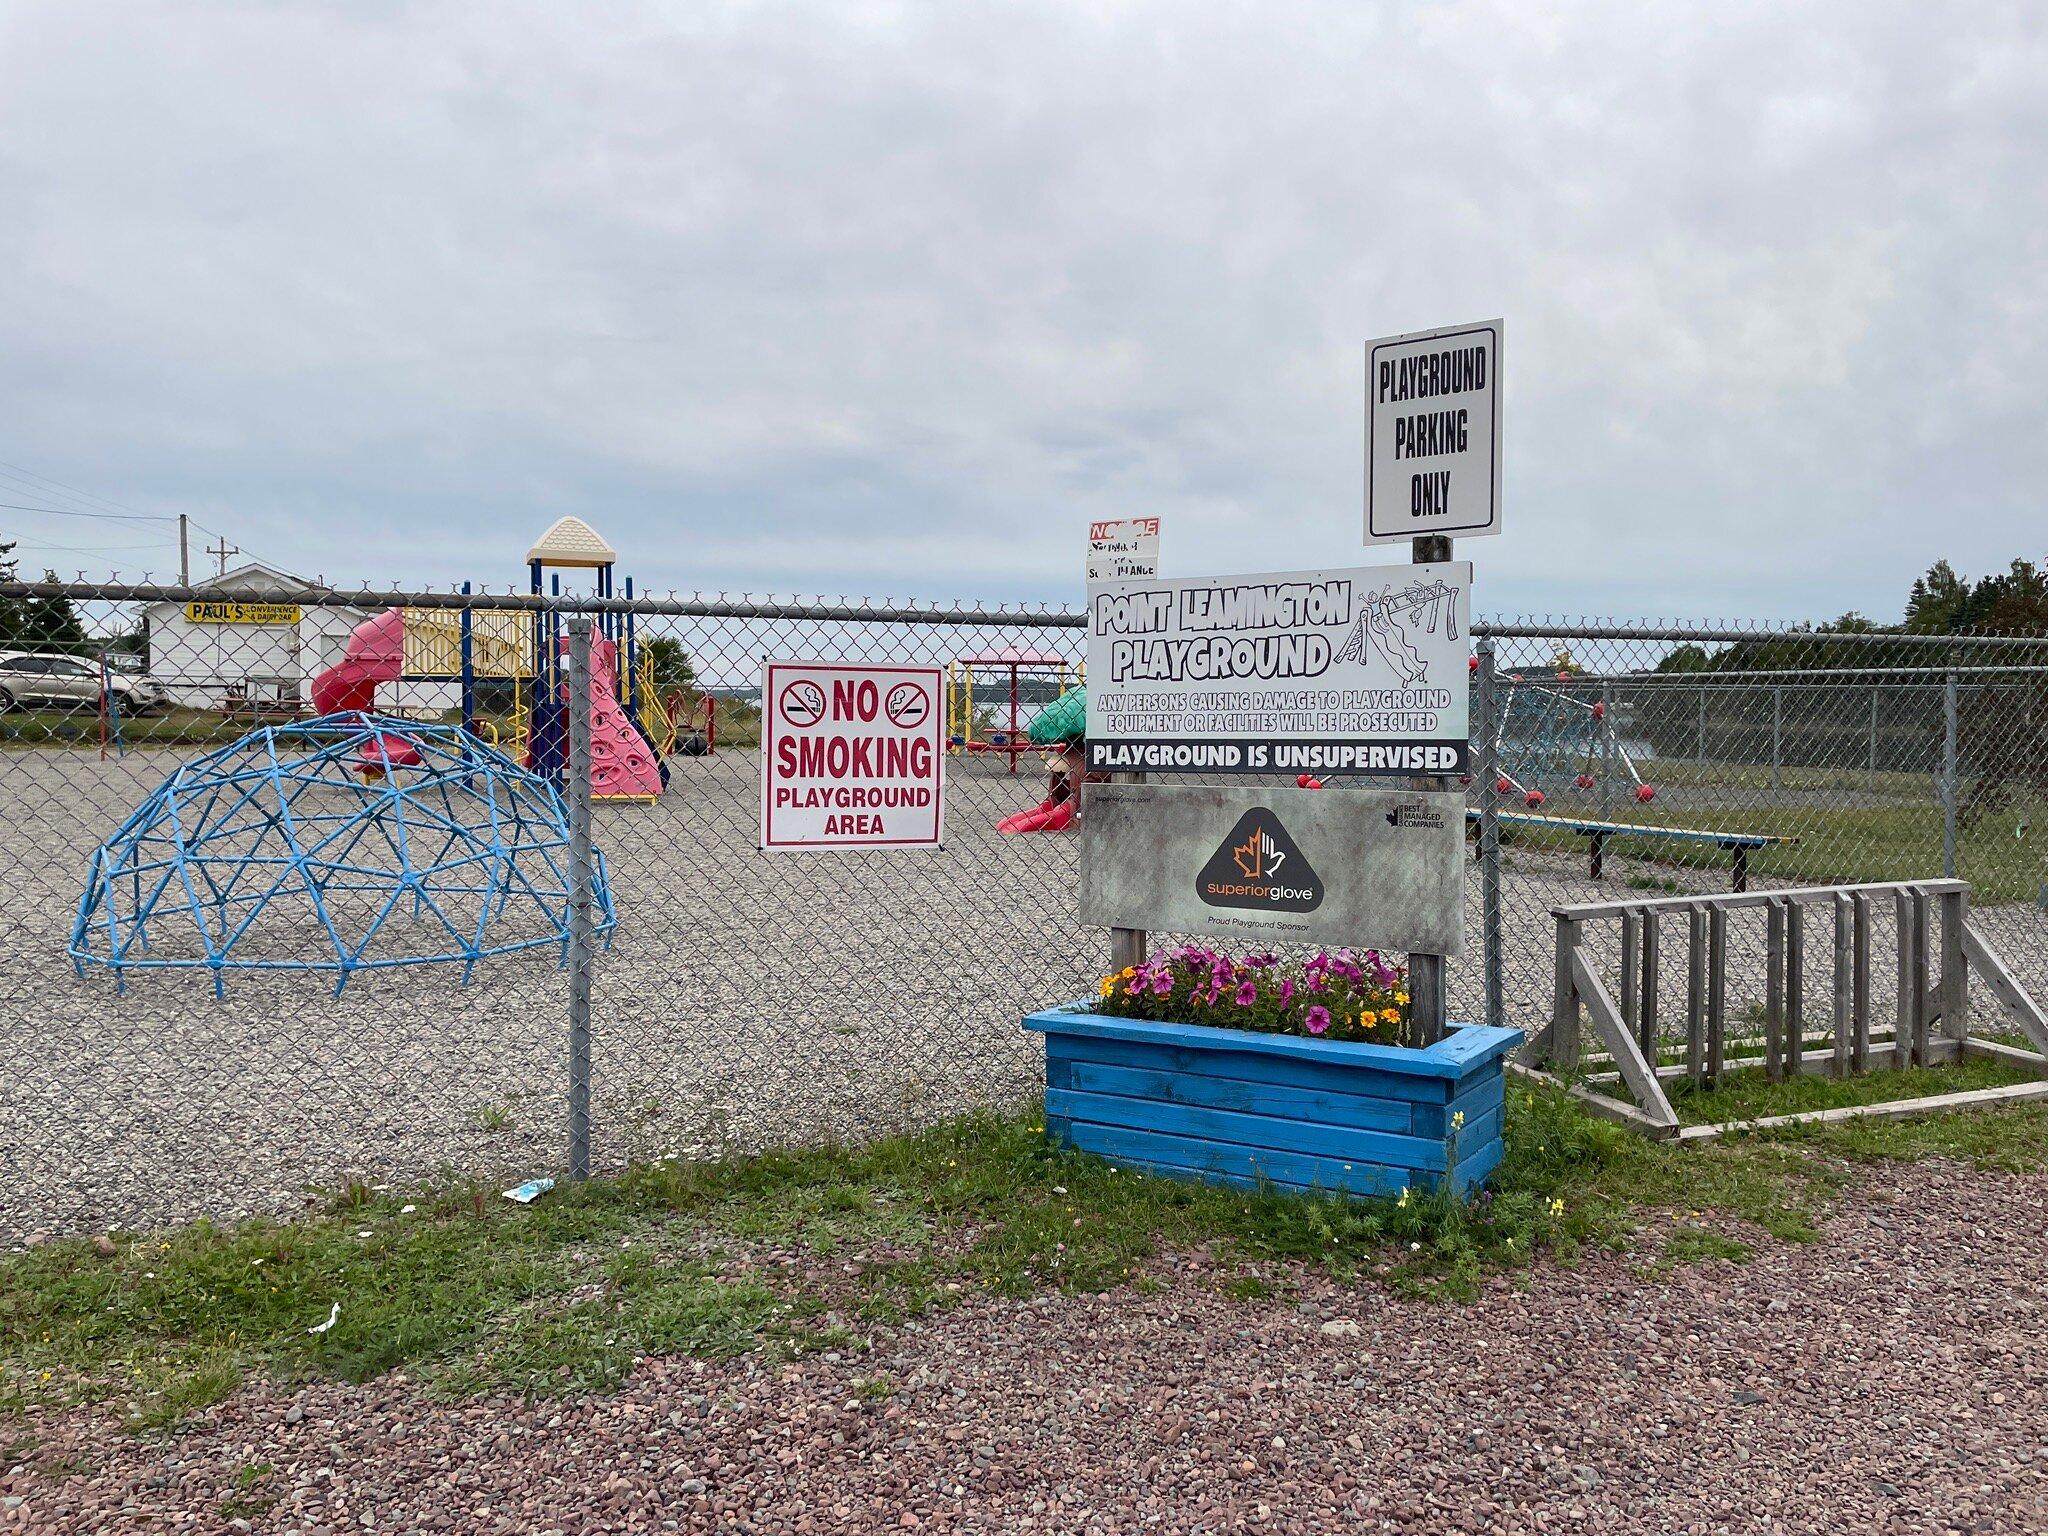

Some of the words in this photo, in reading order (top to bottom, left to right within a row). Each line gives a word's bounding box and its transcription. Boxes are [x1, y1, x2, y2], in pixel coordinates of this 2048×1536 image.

[1380, 346, 1486, 404] PLAYGROUND
[1396, 408, 1468, 460] PARKING
[1411, 470, 1451, 517] ONLY
[1091, 518, 1158, 539] NOE
[193, 604, 244, 619] PAUL'S
[1096, 590, 1173, 636] POINT
[1180, 580, 1352, 632] LEAMINGTON
[1112, 634, 1332, 683] PLAYGROUND
[833, 679, 879, 723] NO
[1097, 693, 1126, 712] ANY
[1128, 692, 1187, 712] PERSONS
[1189, 692, 1251, 712] CAUSING
[1253, 691, 1316, 712] DAMAGE
[1318, 691, 1341, 710] TO
[1343, 689, 1452, 710] PLAYGROUND
[1107, 714, 1182, 734] EQUIPMENT
[1184, 713, 1206, 733] OR
[1207, 713, 1278, 733] FACILITIES
[1280, 713, 1314, 732] WILL
[1316, 712, 1337, 732] BE
[1339, 712, 1439, 732] PROSECUTED
[777, 735, 931, 779] SMOKING
[1093, 745, 1241, 767] PLAYGROUND
[1247, 745, 1268, 767] IS
[1274, 745, 1458, 769] UNSUPERVISED
[776, 787, 931, 808] PLAYGROUND
[824, 814, 885, 835] AREA
[1404, 820, 1445, 829] COMPANIES
[1207, 883, 1313, 901] superiorglove
[1207, 916, 1231, 926] Proud
[1232, 918, 1275, 929] Playground
[1276, 922, 1310, 932] Sponsor
